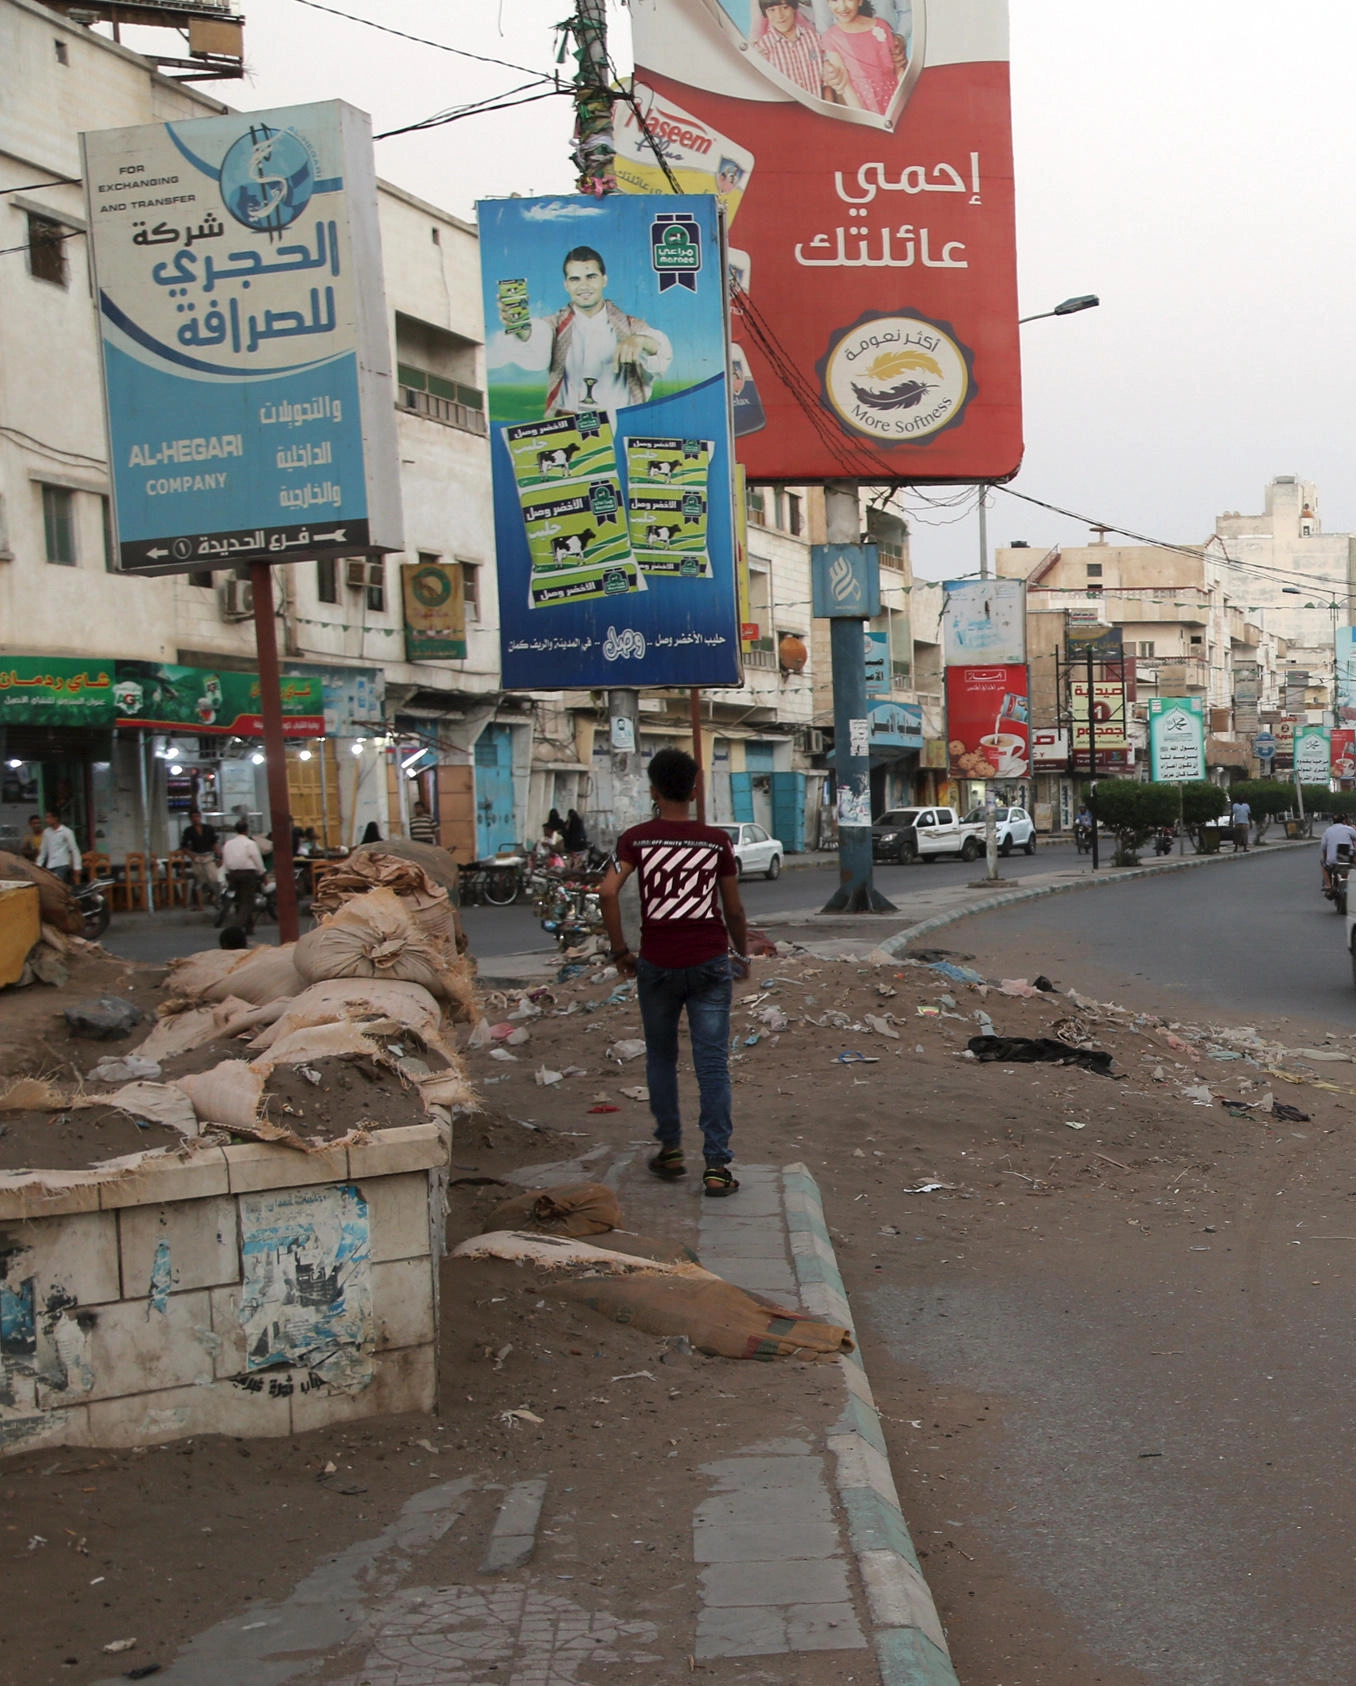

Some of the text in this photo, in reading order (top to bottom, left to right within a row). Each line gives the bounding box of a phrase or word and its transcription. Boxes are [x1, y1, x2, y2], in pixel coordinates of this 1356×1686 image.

[98, 176, 179, 193] EXCHANGING
[119, 165, 145, 175] FOR
[834, 152, 982, 217] إحمي
[100, 194, 196, 213] AND TRANSFER
[133, 212, 224, 246] شركة
[152, 220, 340, 298] الحجري
[794, 224, 969, 269] عائلتك
[177, 286, 336, 353] للصرافة
[846, 329, 942, 361] أكثر نعومة
[259, 395, 342, 429] والتحويلات
[851, 397, 953, 433] More Softness
[128, 434, 243, 467] AL-HEGARI
[276, 441, 332, 472] الداخلية
[146, 472, 228, 496] COMPANY
[279, 481, 342, 510] والخارجية
[197, 530, 266, 557] الحديدة
[269, 527, 310, 551] فرع
[580, 636, 592, 652] في
[603, 625, 647, 661] وصل
[655, 633, 674, 647] وصل
[704, 635, 726, 648] حليب
[1074, 685, 1124, 699] صيدية
[1094, 705, 1103, 720] 1
